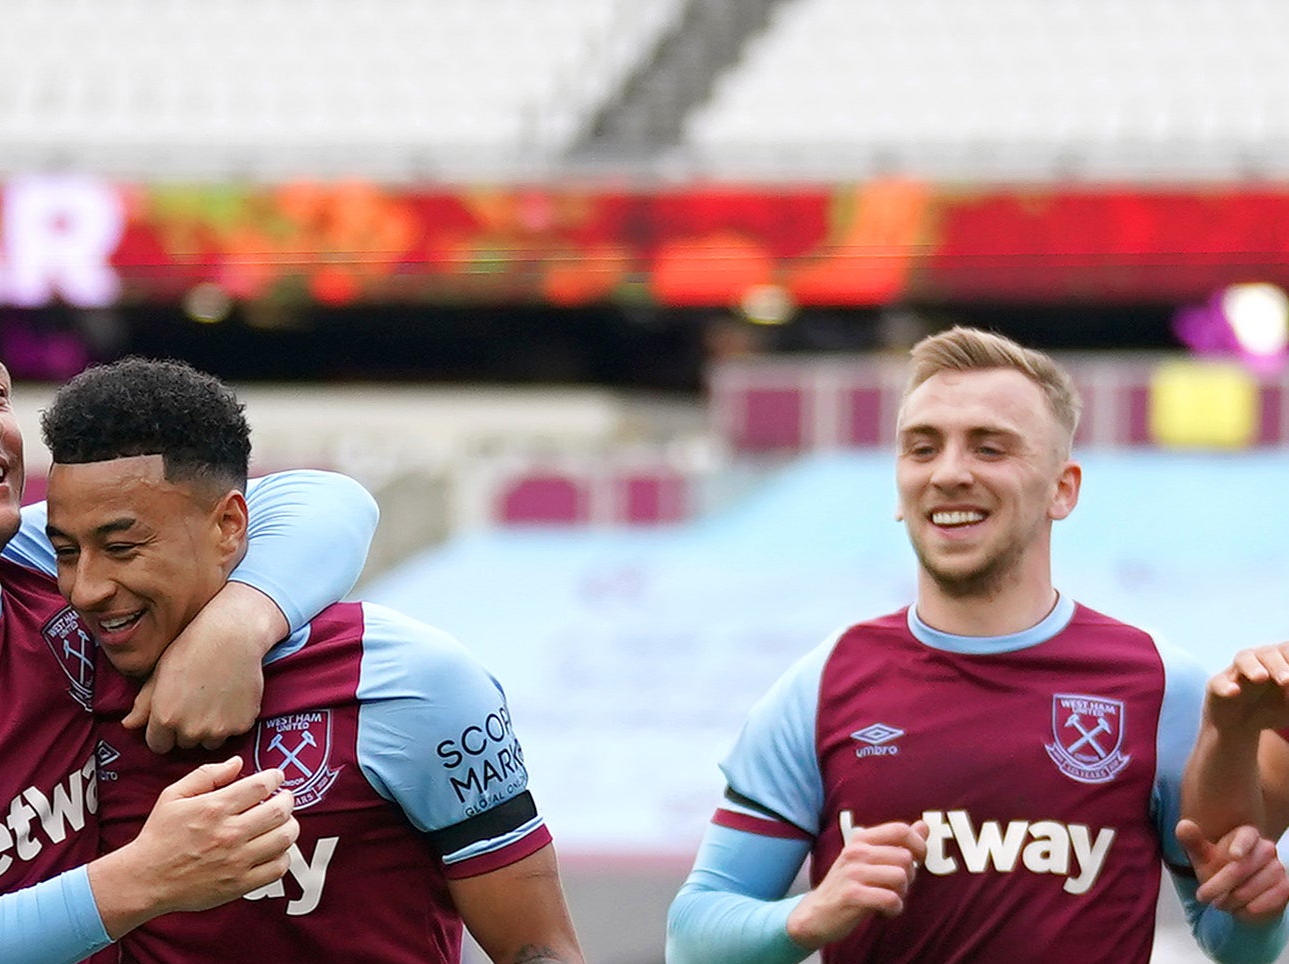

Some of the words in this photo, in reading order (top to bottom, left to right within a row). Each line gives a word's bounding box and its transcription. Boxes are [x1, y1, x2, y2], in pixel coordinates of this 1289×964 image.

[266, 714, 294, 729] WEST
[295, 712, 322, 723] HAM
[276, 722, 310, 732] UNITED
[855, 744, 899, 758] umbro
